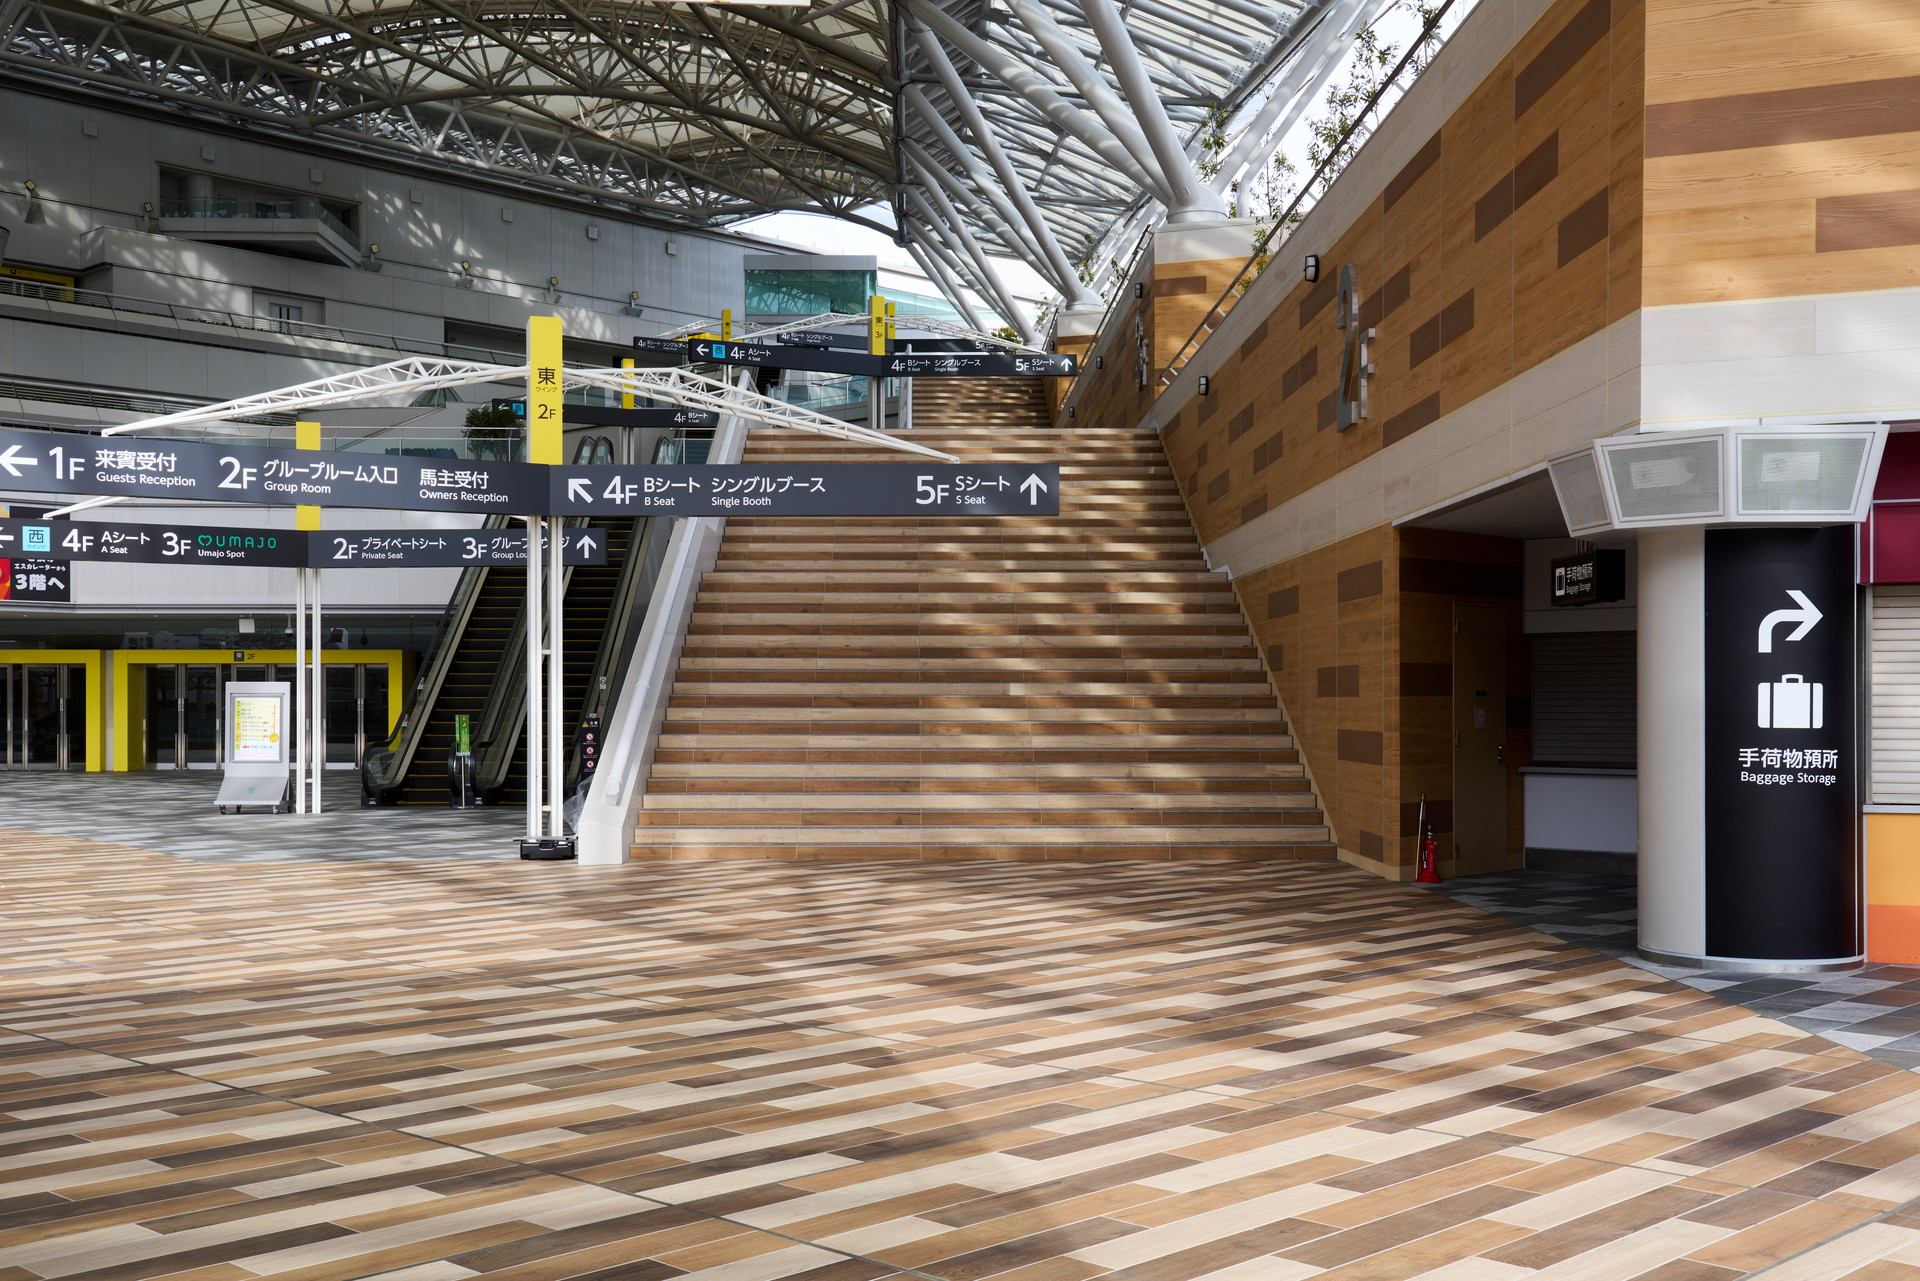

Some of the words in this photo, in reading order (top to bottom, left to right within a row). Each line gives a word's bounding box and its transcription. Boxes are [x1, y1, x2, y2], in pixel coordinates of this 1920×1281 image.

[638, 339, 647, 348] 4F
[1336, 263, 1376, 433] 2F
[730, 346, 745, 360] 4F
[748, 348, 772, 357] Aシート
[891, 359, 905, 372] 4F
[907, 359, 931, 367] Bシート
[934, 359, 981, 367] シングルブース
[1015, 358, 1029, 371] 5F
[537, 367, 556, 385] 東
[538, 403, 556, 419] 2F
[674, 412, 687, 423] 4F
[49, 446, 85, 480] 1F
[95, 448, 177, 473] 来賓受付
[217, 456, 257, 490] 2F
[263, 459, 398, 485] グループルーム入口
[419, 468, 489, 490] 馬主受付
[96, 472, 136, 484] Guests
[139, 474, 196, 488] Reception
[264, 480, 298, 494] Group
[301, 483, 331, 494] Room
[643, 476, 700, 493] Bシート
[711, 475, 826, 493] シングルブース
[955, 475, 1011, 491] Sシート
[419, 489, 458, 500] Owners
[460, 491, 509, 504] Reception
[602, 475, 638, 504] 4F
[915, 475, 949, 505] 5F
[644, 496, 651, 506] B
[653, 496, 675, 506] Seat
[711, 496, 740, 508] Single
[742, 496, 771, 506] Booth
[956, 495, 962, 504] S
[964, 495, 986, 504] Seat
[28, 529, 44, 543] 西
[62, 528, 94, 552] 4F
[101, 530, 151, 545] Aシート
[215, 535, 277, 549] UMAJO
[361, 537, 447, 550] プライベートシート
[109, 546, 128, 554] Seat
[162, 532, 191, 556] 3F
[332, 537, 358, 559] 2F
[462, 536, 488, 559] 3F
[198, 549, 225, 559] Umajo
[226, 550, 245, 559] Spot
[491, 551, 514, 560] Group
[14, 563, 66, 571] エスカレーターから
[15, 573, 66, 591] 3階へ
[1738, 747, 1839, 769] 手荷物預所
[1741, 771, 1794, 785] Baggage
[1797, 772, 1837, 786] Storage
